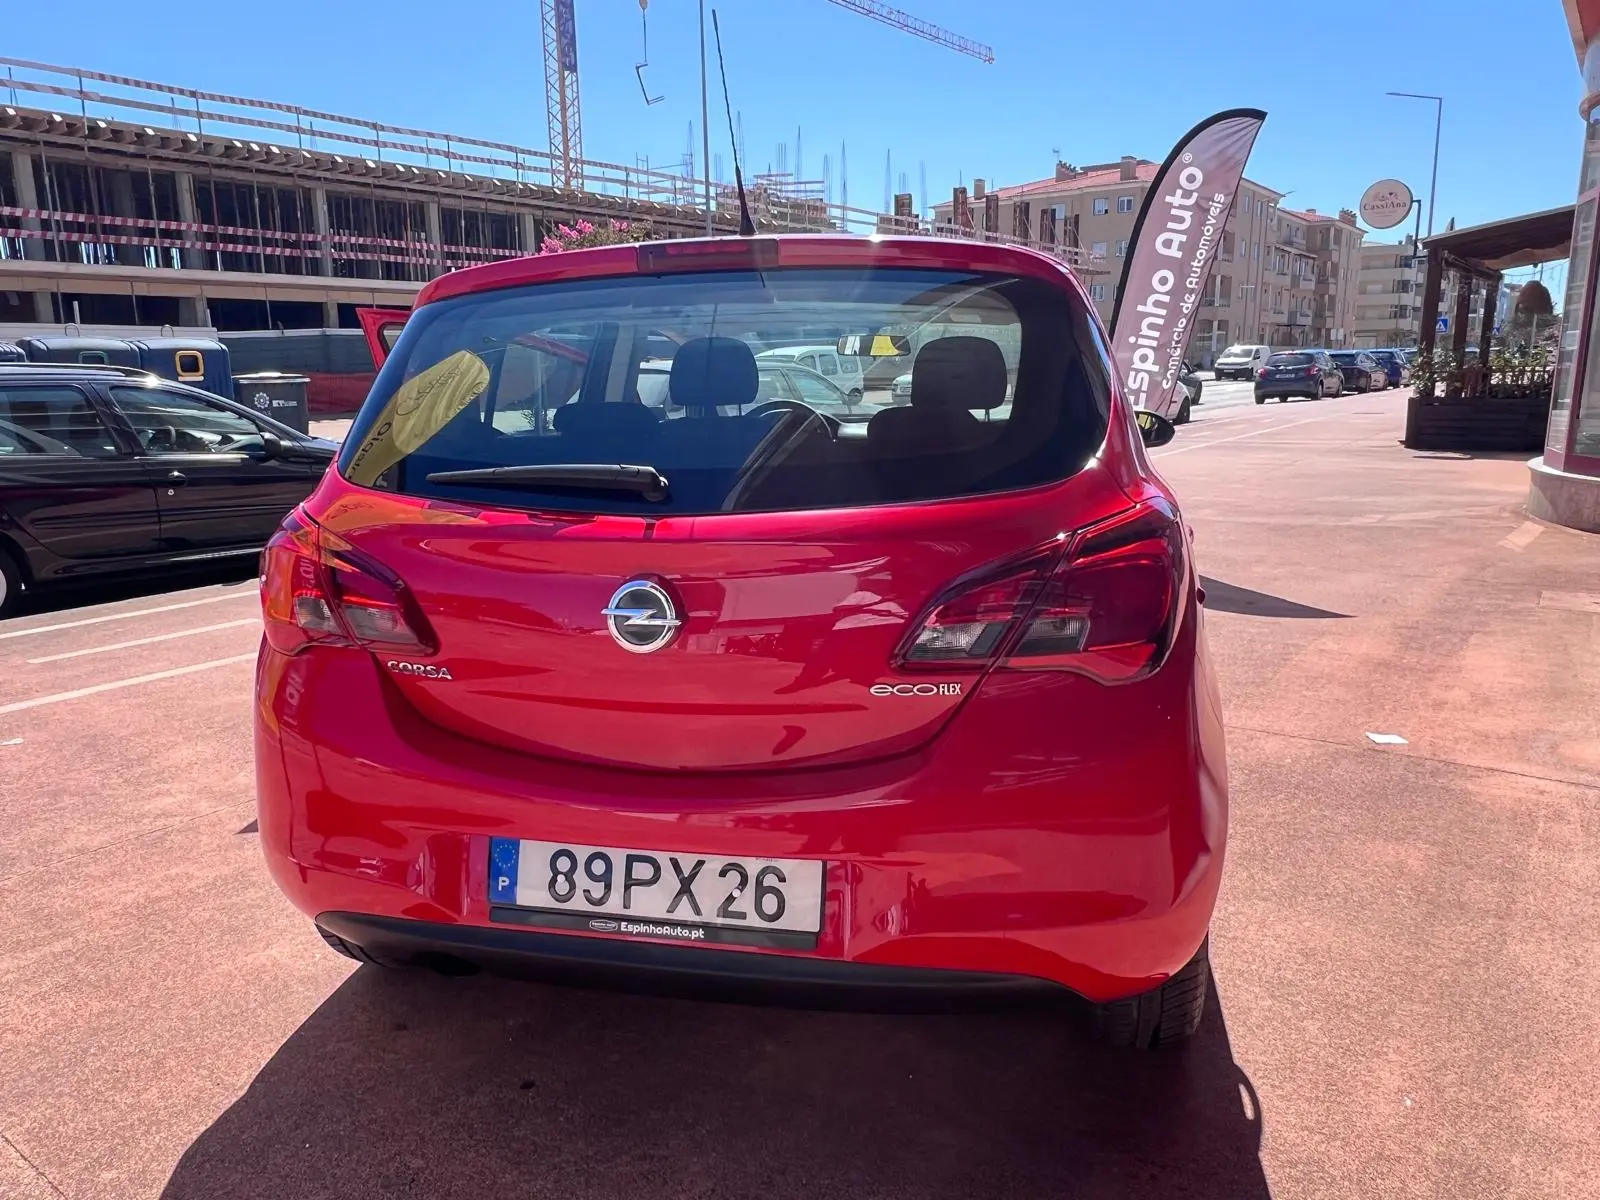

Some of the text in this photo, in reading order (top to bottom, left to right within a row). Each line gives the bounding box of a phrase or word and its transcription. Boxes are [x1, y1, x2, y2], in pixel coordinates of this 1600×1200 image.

[1185, 193, 1225, 289] Automóveis
[1180, 293, 1196, 314] de
[1124, 269, 1175, 411] Espinho
[387, 661, 453, 680] CORSA
[498, 876, 510, 891] P
[620, 922, 705, 940] EspinhoAuto.pt
